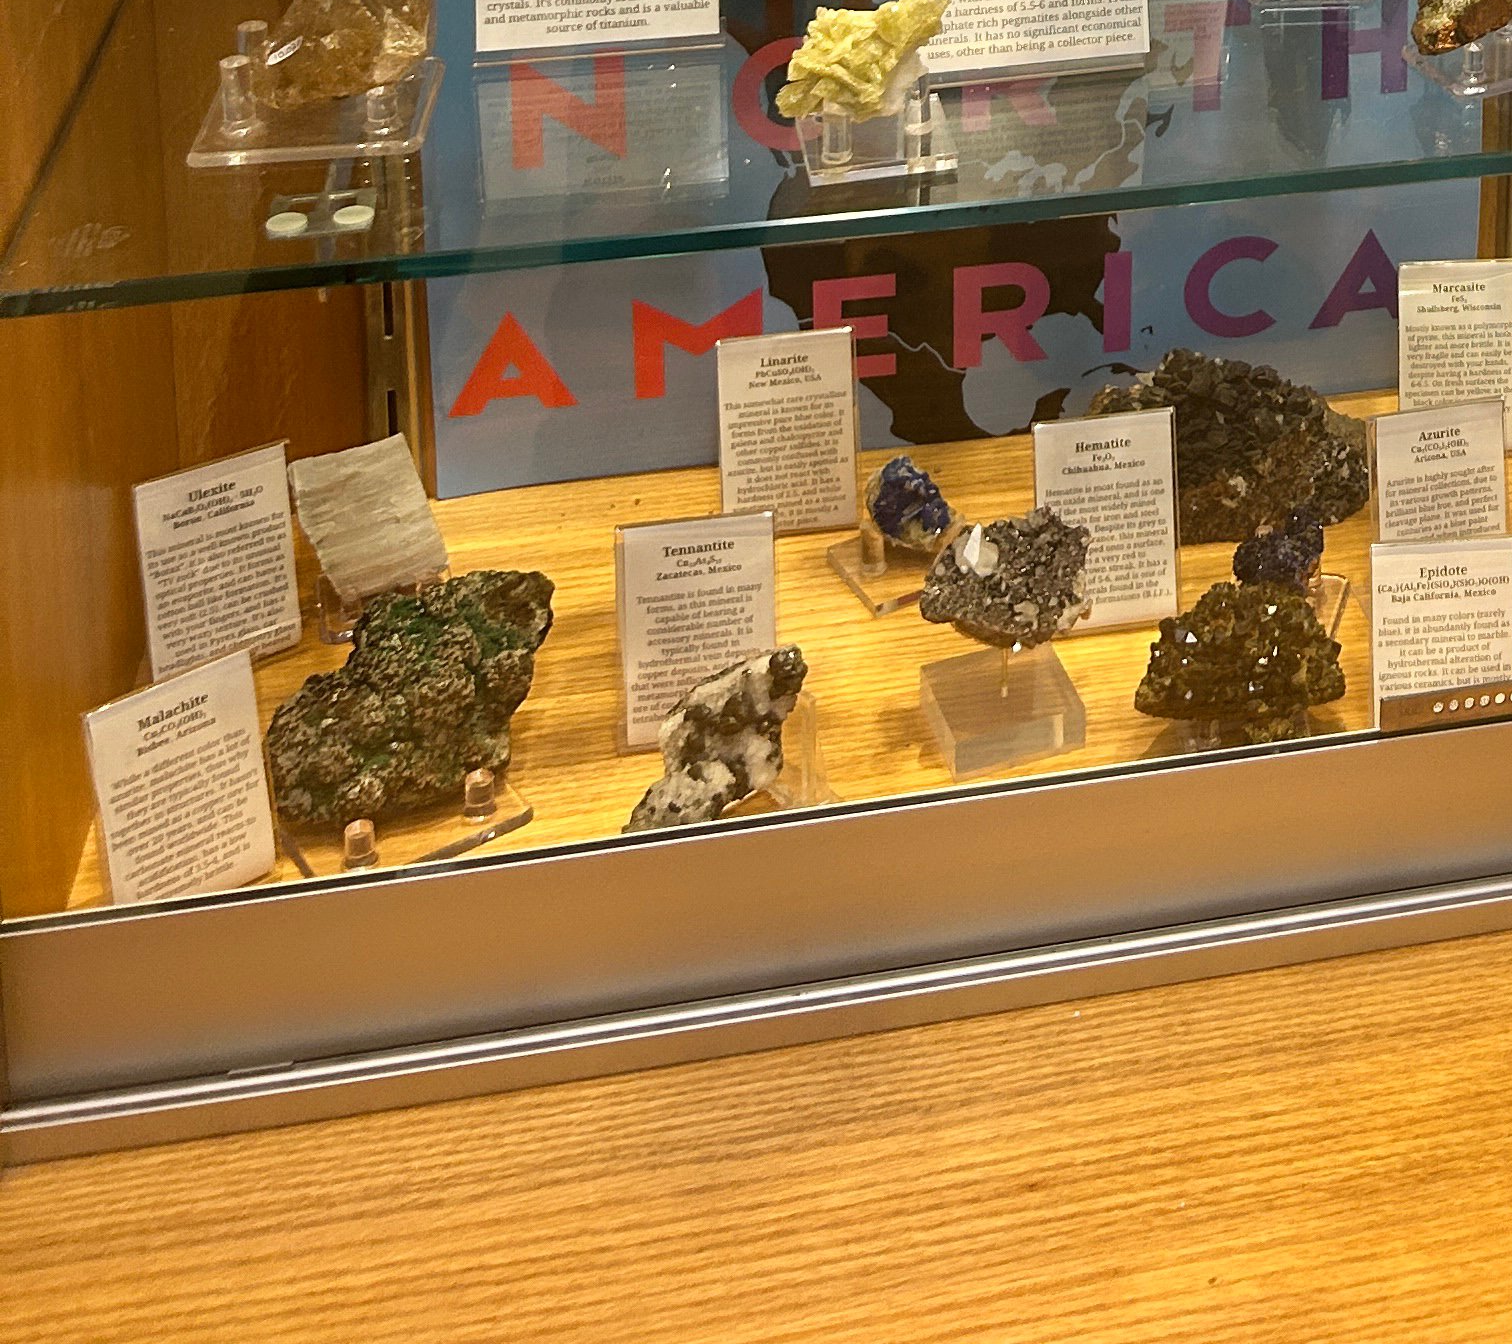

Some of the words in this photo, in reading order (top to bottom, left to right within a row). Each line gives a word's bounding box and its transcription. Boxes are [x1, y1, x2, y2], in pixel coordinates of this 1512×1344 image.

[1433, 282, 1485, 294] Marcasite
[449, 229, 1399, 419] AMERICA
[760, 353, 808, 367] Linarite
[768, 376, 802, 387] Mexico,
[1418, 427, 1460, 441] Azurite
[1075, 437, 1131, 452] Hematite
[1113, 458, 1145, 469] Mexico
[187, 480, 237, 502] Ulexite
[663, 539, 734, 557] Tennantite
[707, 563, 742, 574] Mexico
[1419, 564, 1467, 580] Epidote
[1464, 586, 1496, 598] Mexico
[135, 693, 210, 730] Malachite
